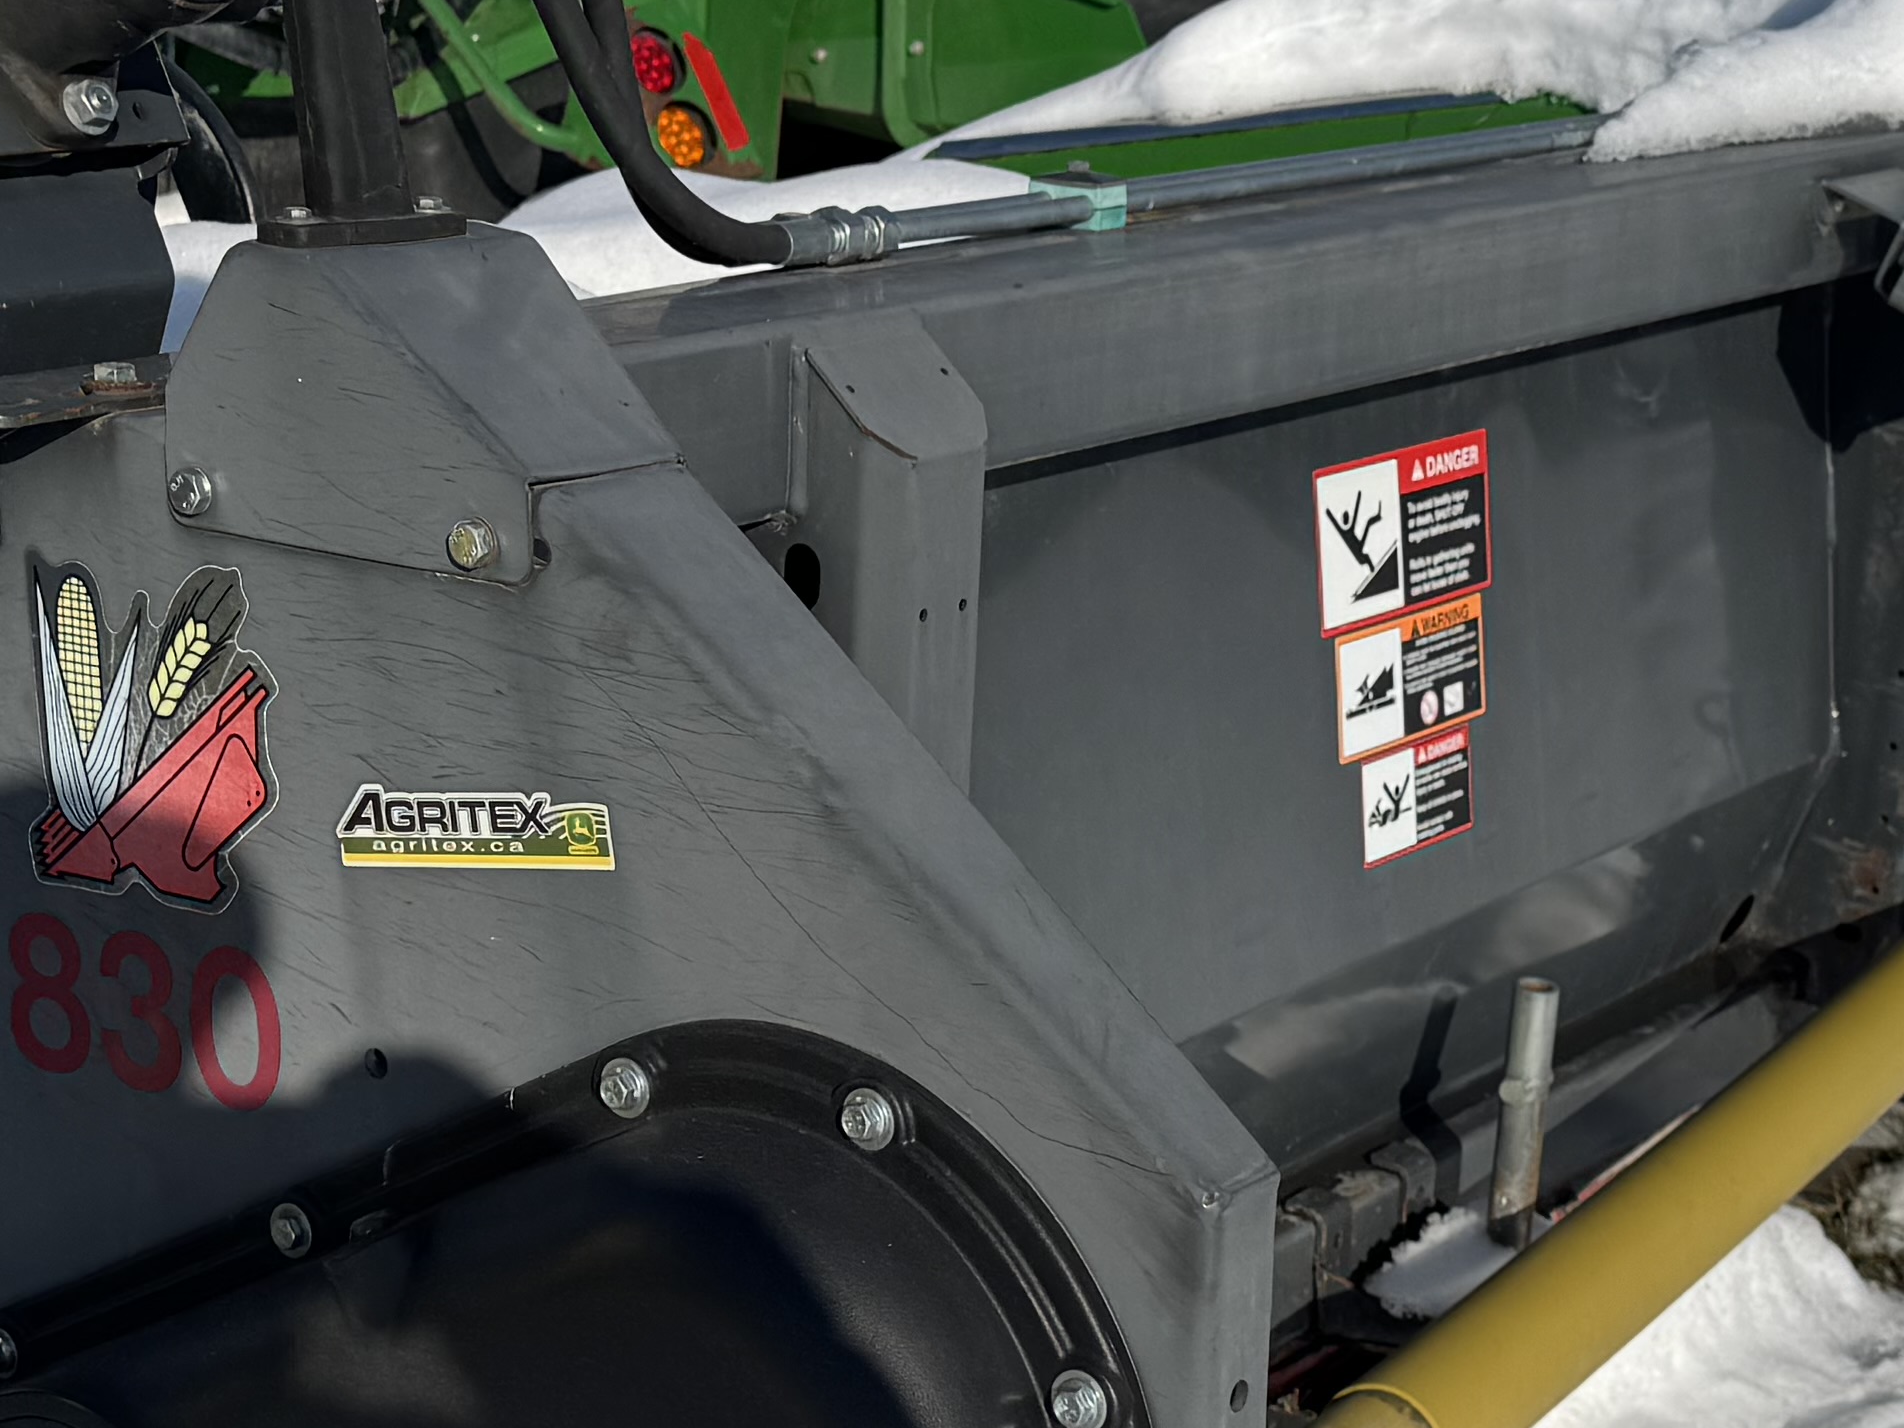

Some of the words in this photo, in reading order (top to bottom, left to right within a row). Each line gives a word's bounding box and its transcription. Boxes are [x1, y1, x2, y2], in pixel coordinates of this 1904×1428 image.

[1425, 445, 1480, 478] DANGER
[1421, 603, 1470, 632] WARNING
[341, 790, 553, 837] AGRITEX
[372, 837, 526, 854] agritex.ca
[7, 912, 282, 1112] 830
